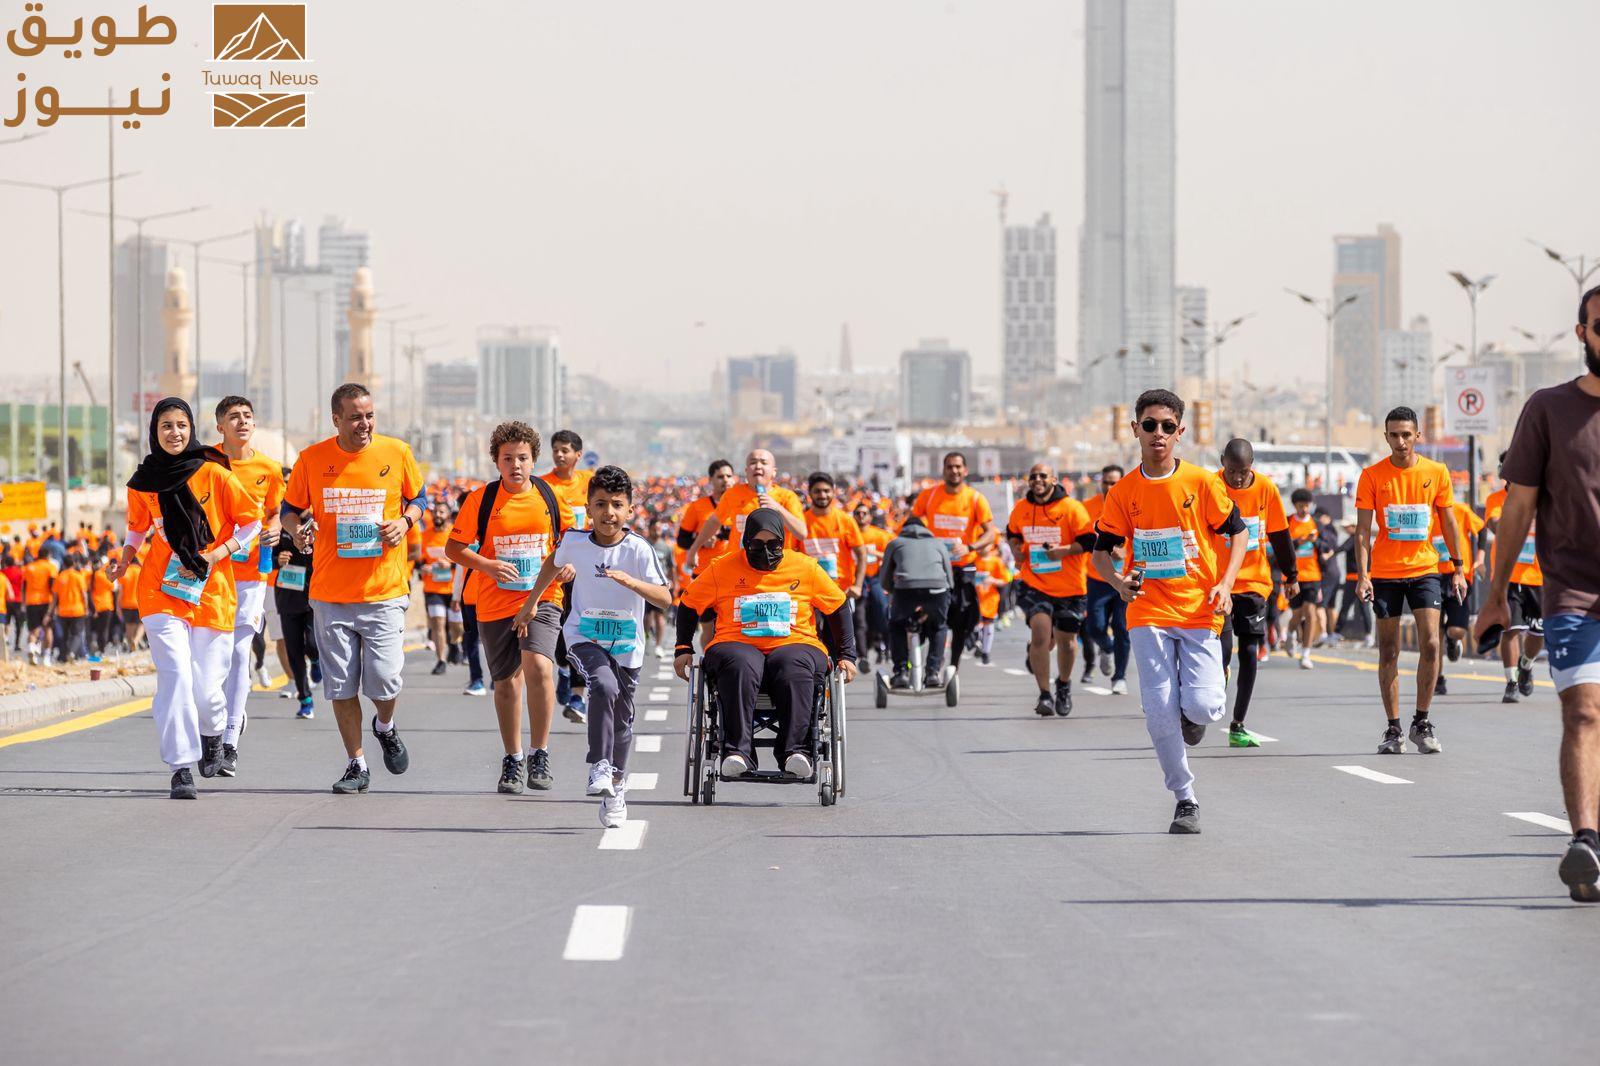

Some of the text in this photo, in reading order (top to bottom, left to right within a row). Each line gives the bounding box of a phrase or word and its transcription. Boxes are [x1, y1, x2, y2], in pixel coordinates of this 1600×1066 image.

[349, 525, 373, 538] 53309
[1142, 541, 1168, 556] 51923
[754, 604, 779, 617] 46212
[595, 621, 622, 635] 41175
